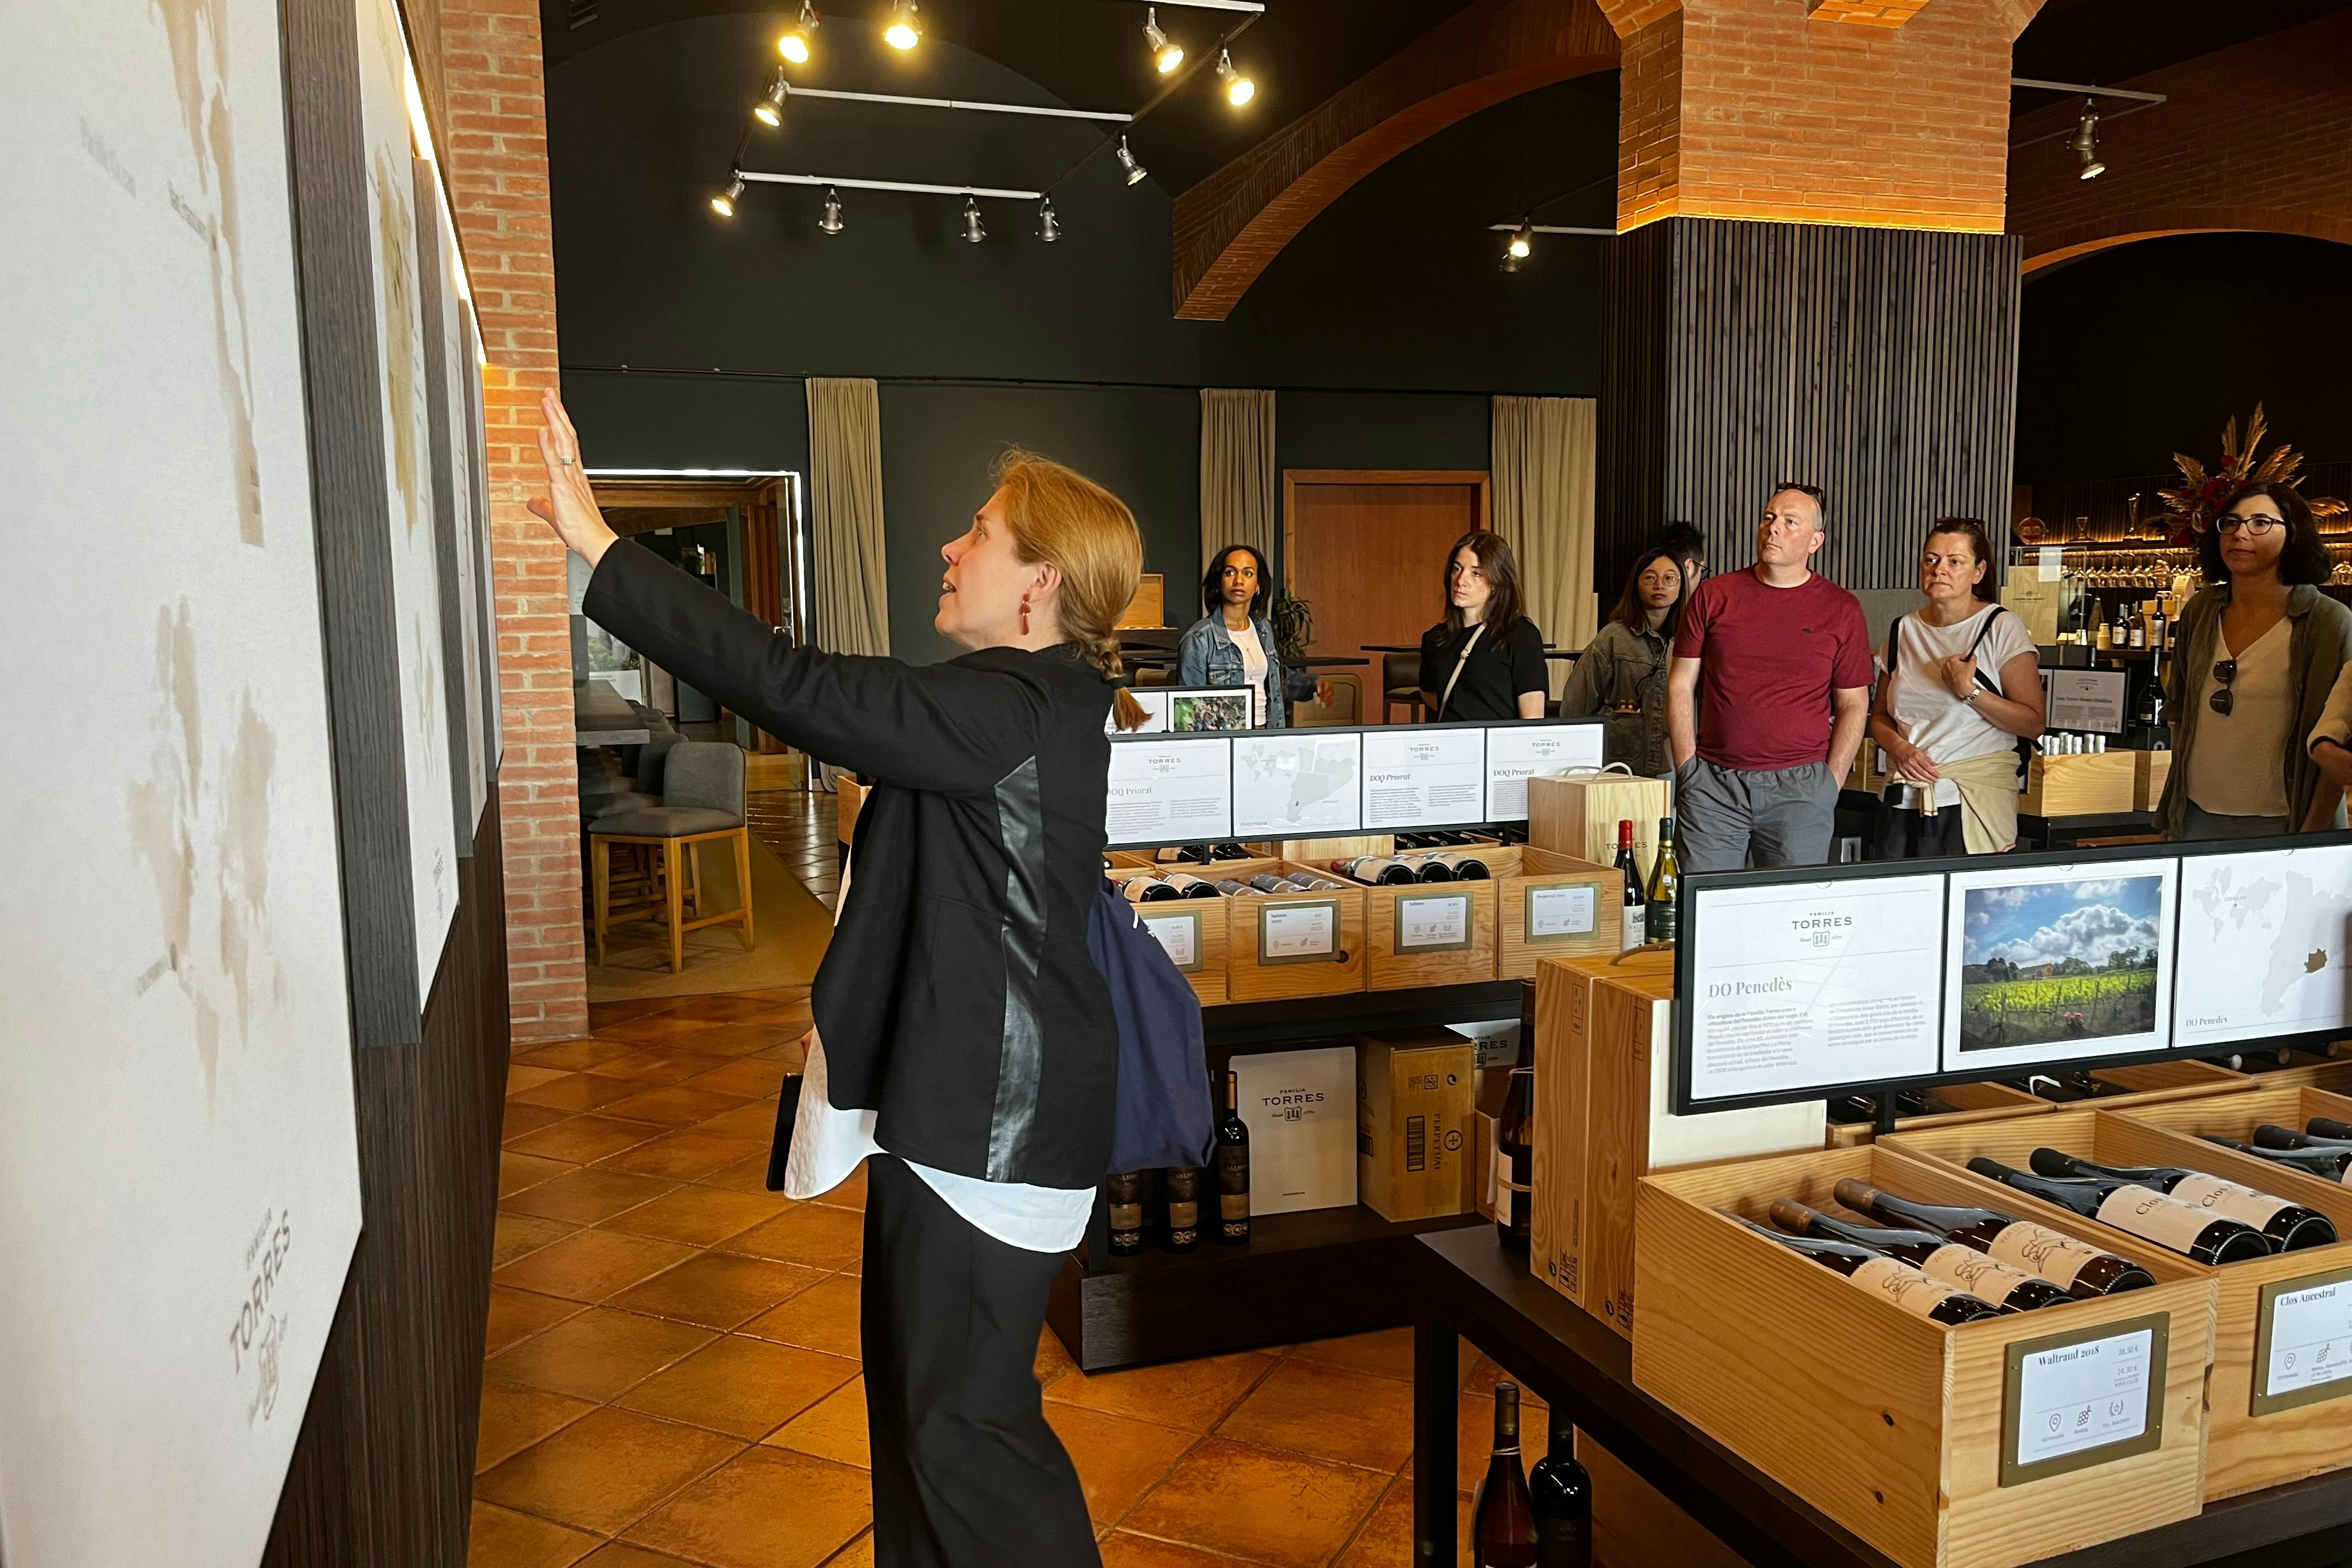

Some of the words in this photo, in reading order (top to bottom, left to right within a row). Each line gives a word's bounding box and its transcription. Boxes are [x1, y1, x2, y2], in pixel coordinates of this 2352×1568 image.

[1791, 916, 1852, 930] TORRES
[1709, 983, 1731, 998] DO
[1736, 976, 1793, 995] Penedès
[1262, 1093, 1324, 1106] TORRES
[1433, 1112, 1441, 1172] PERPETUAL
[2202, 1186, 2228, 1208] Clos
[230, 1209, 290, 1374] TORRES
[2280, 1296, 2298, 1307] Clos
[2299, 1287, 2336, 1303] Ancestral
[2039, 1349, 2078, 1366] Waltraud
[2081, 1345, 2099, 1357] 2018
